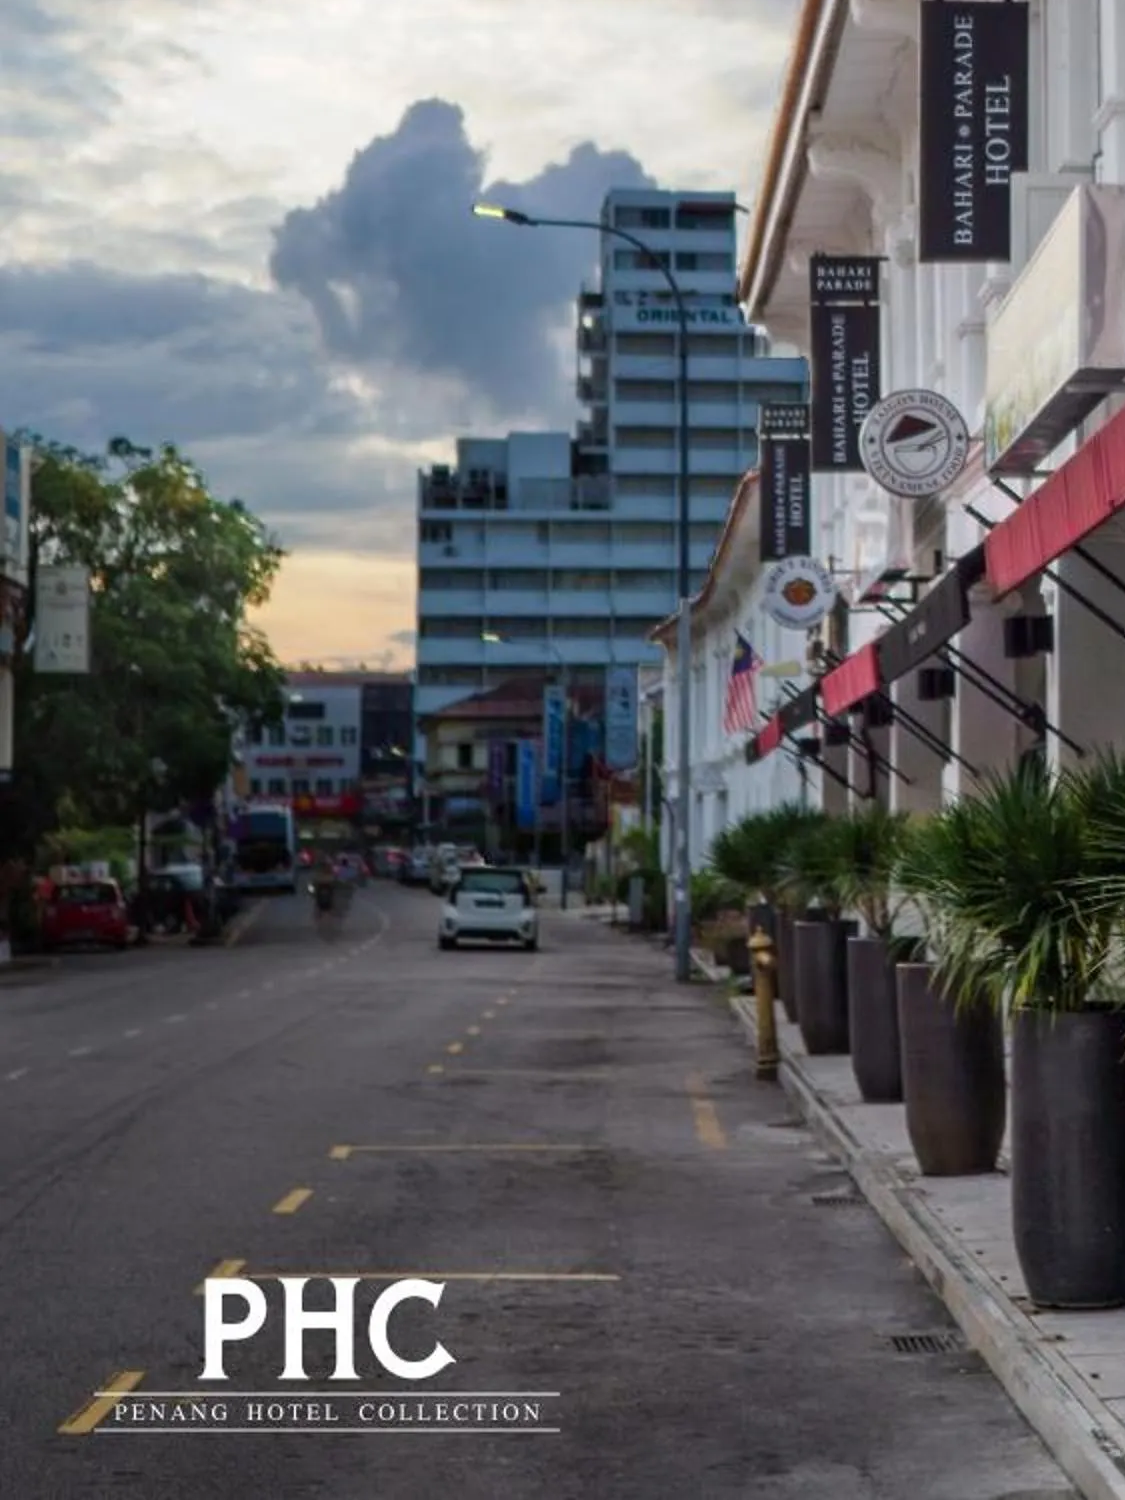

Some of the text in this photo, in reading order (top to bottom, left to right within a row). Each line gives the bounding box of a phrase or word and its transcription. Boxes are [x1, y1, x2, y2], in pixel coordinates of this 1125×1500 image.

[953, 14, 974, 245] BAHARI PARADE
[984, 74, 1010, 185] HOTEL
[636, 307, 732, 325] ORIENTAL
[851, 352, 869, 424] HOTEL
[831, 396, 847, 463] BAHARI
